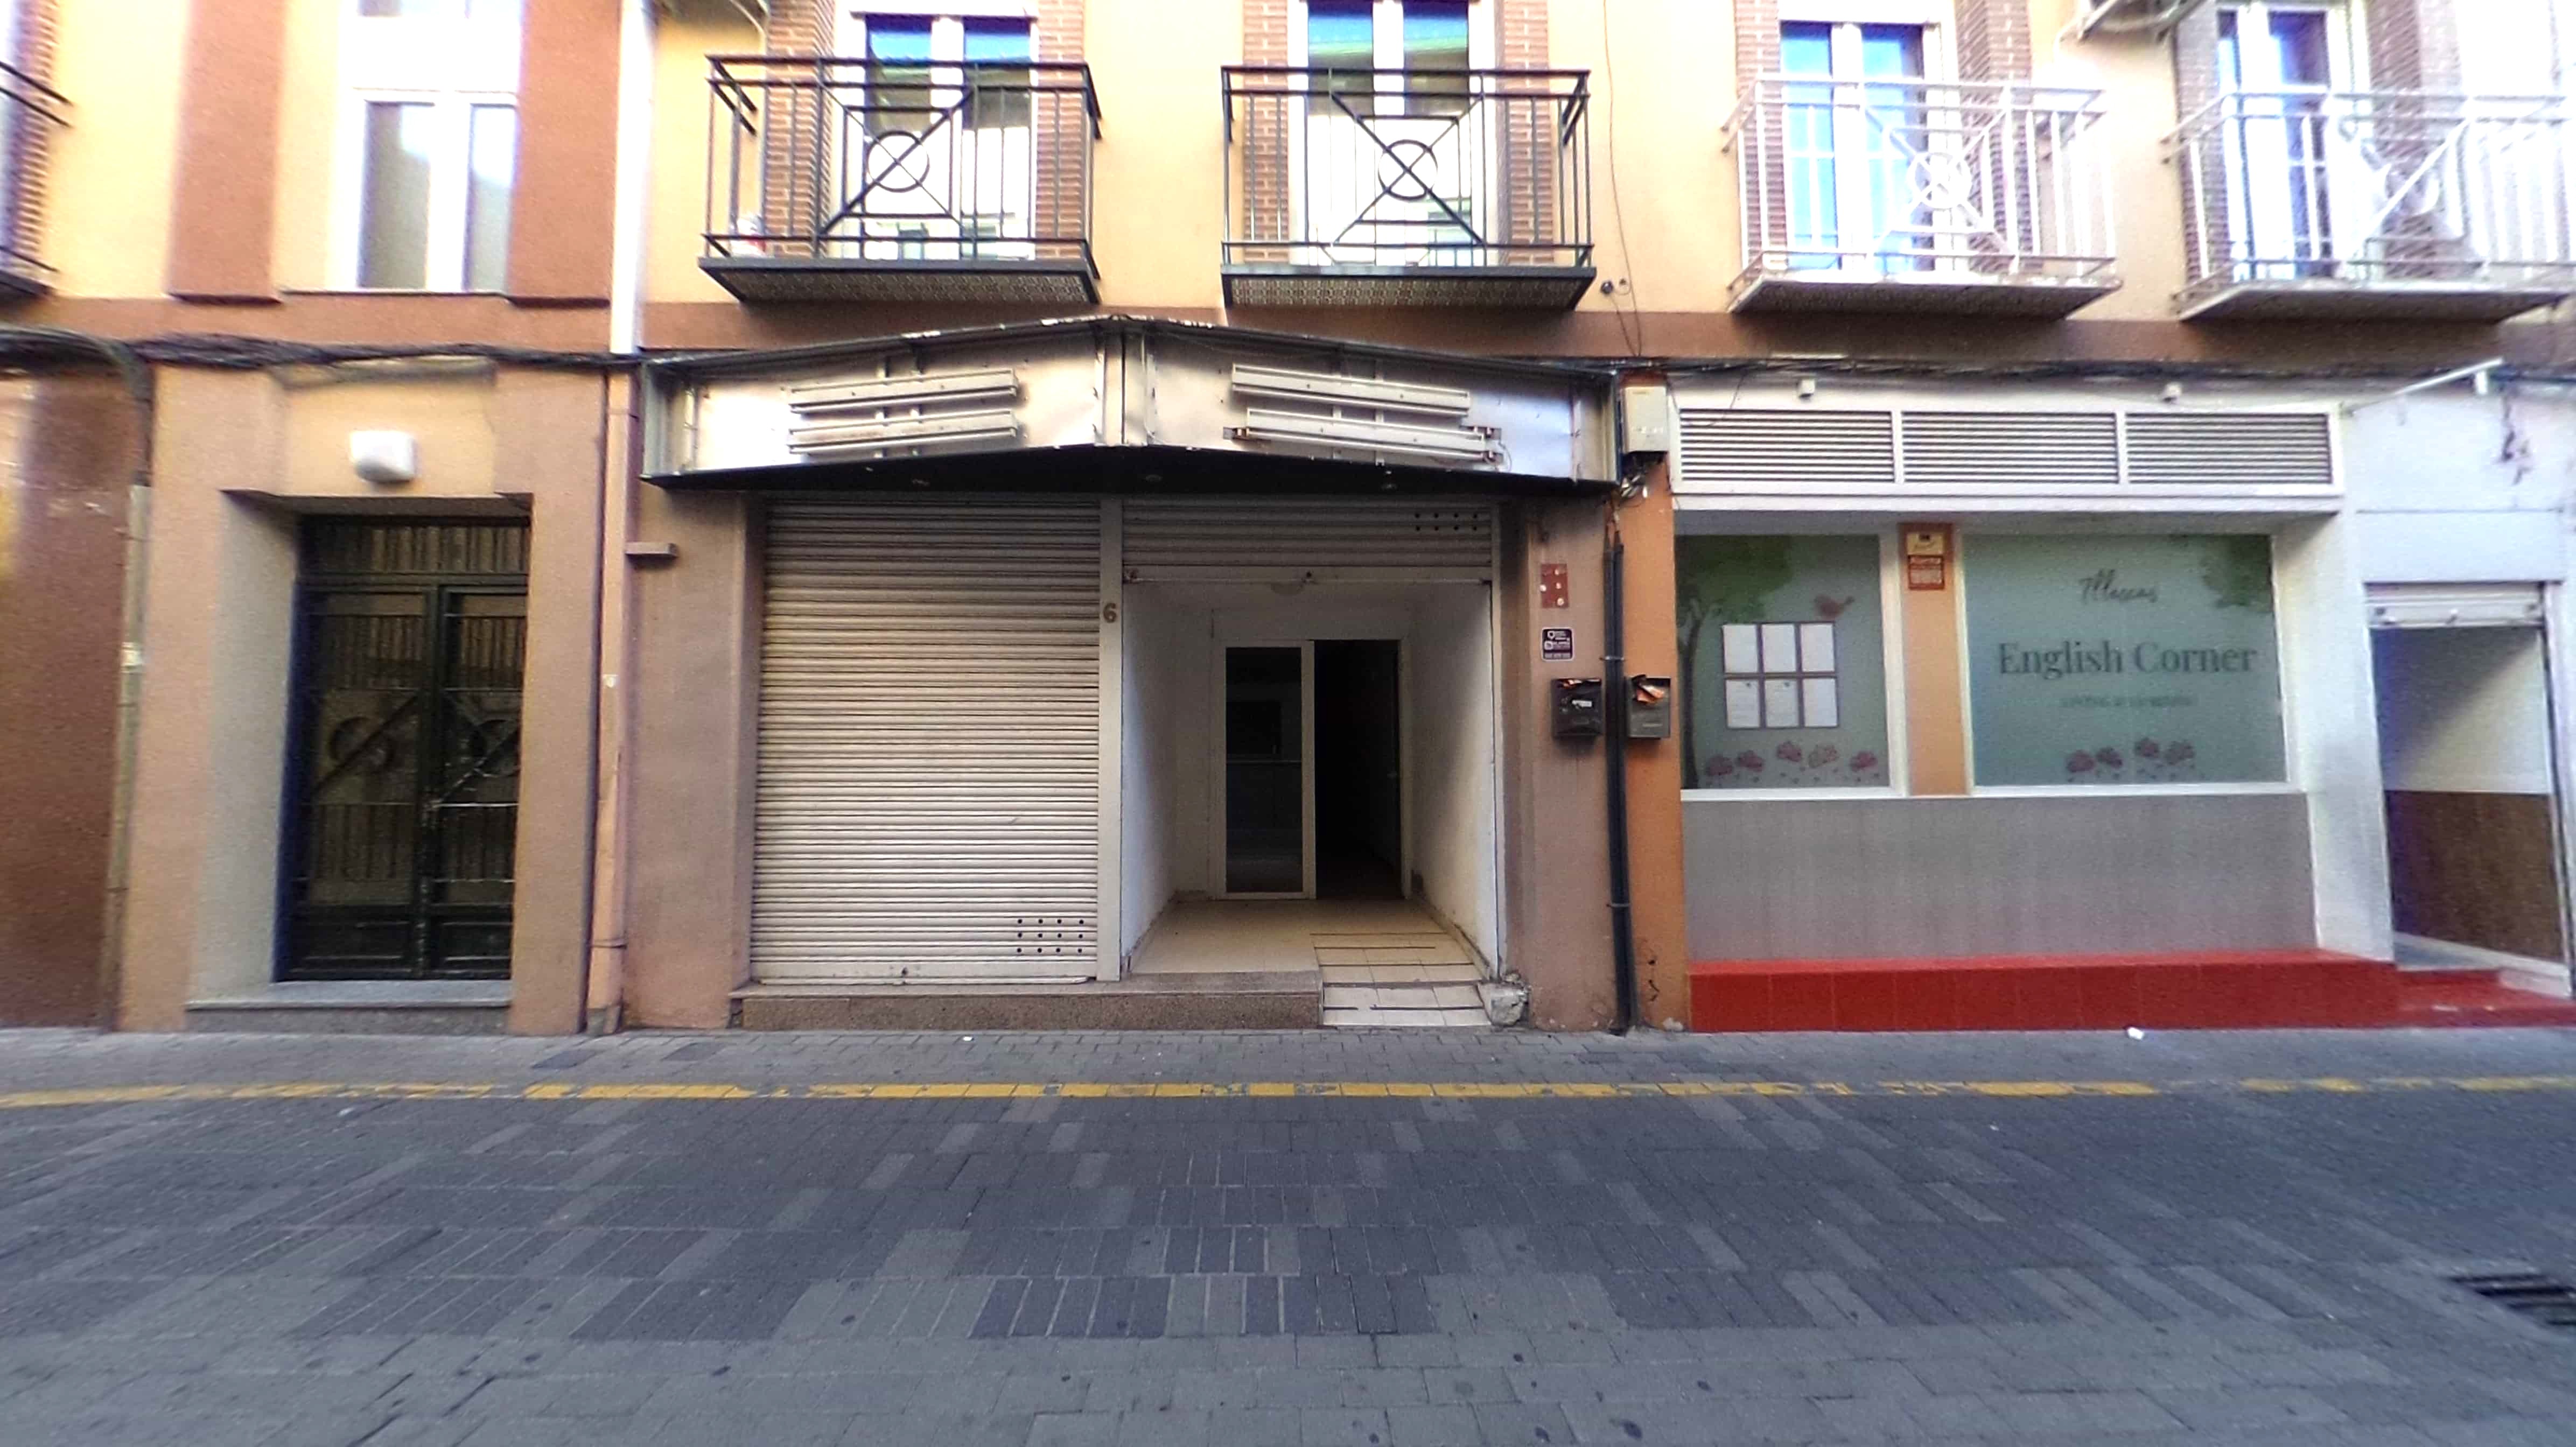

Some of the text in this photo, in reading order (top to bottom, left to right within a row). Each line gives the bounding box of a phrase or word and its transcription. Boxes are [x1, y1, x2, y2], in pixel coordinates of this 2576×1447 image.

[1103, 602, 1117, 623] 6
[1999, 640, 2258, 680] English Corner
